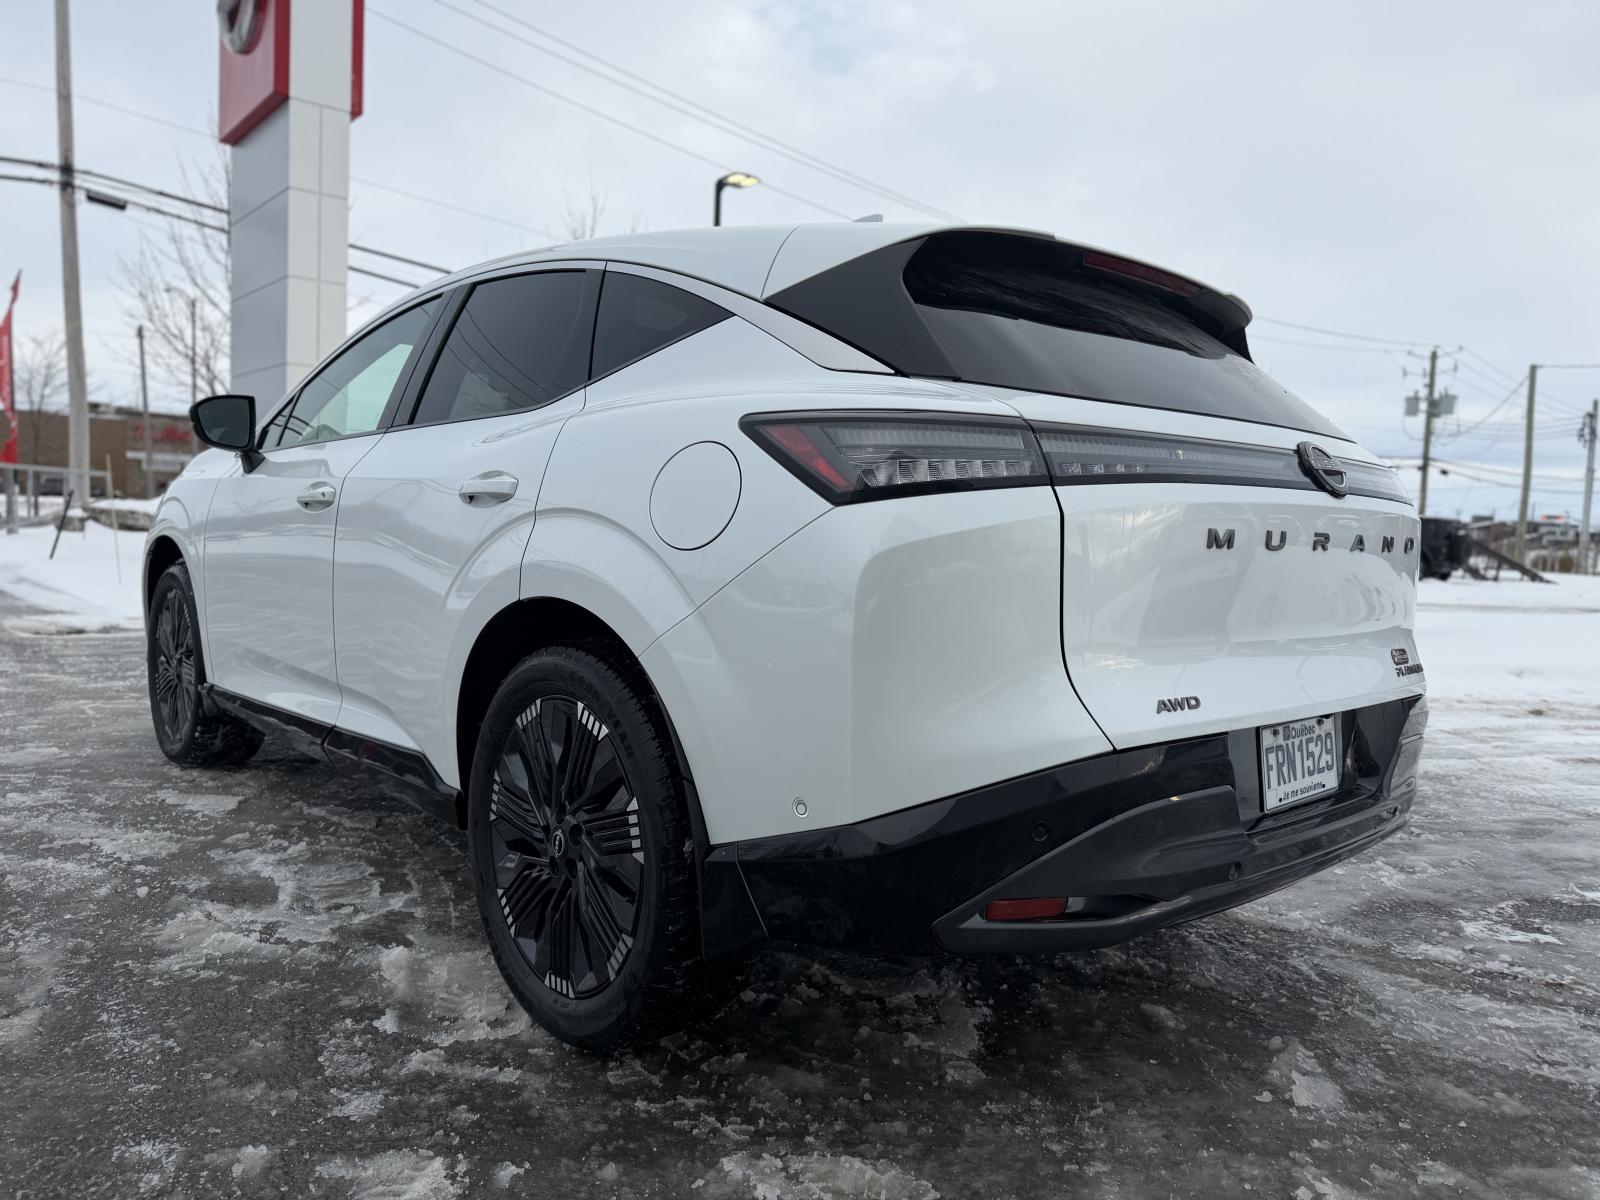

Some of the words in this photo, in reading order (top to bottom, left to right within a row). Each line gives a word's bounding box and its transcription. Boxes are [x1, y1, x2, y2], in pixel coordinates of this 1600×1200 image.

[1206, 528, 1415, 553] MURANO
[1156, 695, 1201, 714] AWD
[1265, 732, 1334, 789] FRN1529
[1283, 791, 1290, 801] Je
[1291, 787, 1299, 798] me
[1300, 780, 1323, 795] souviens
